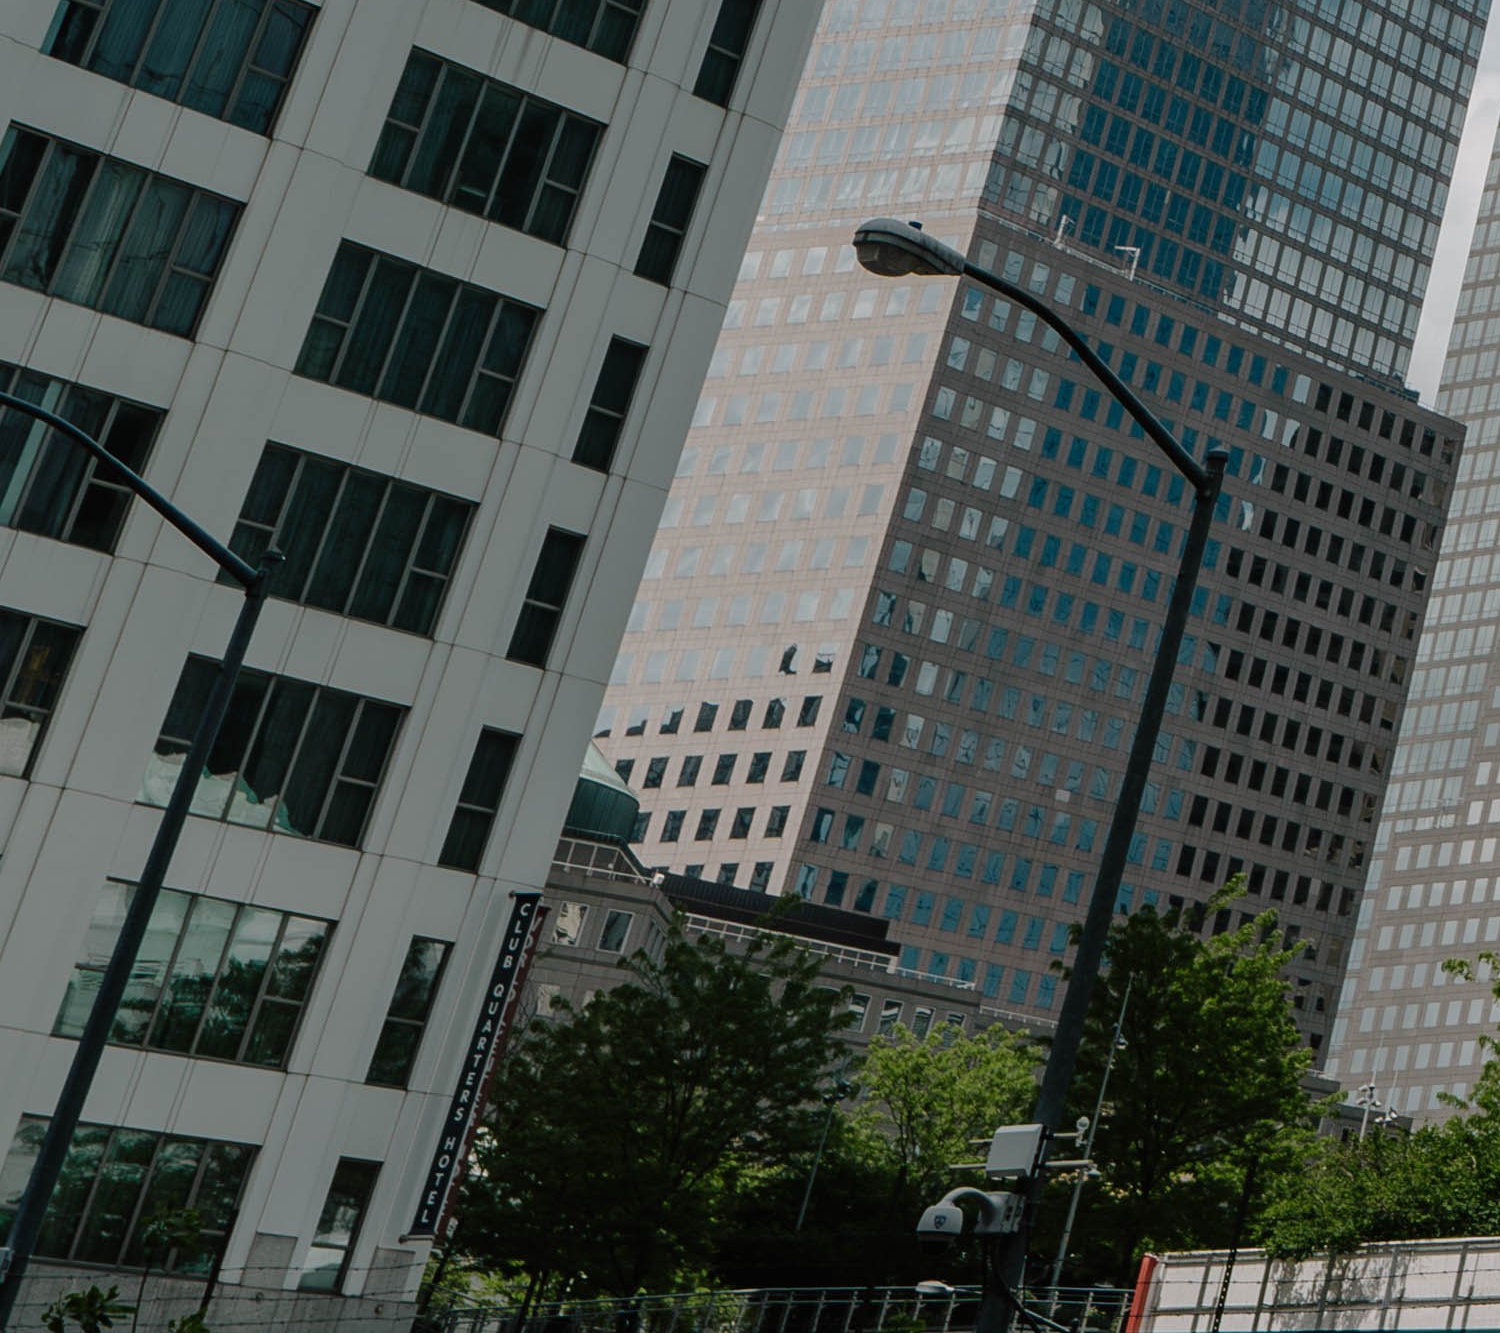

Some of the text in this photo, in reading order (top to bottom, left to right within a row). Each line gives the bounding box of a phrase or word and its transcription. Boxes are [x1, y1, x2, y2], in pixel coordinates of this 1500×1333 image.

[503, 902, 532, 969] CLUB
[453, 983, 506, 1122] QUARTERS
[420, 1136, 457, 1223] HOTEL
